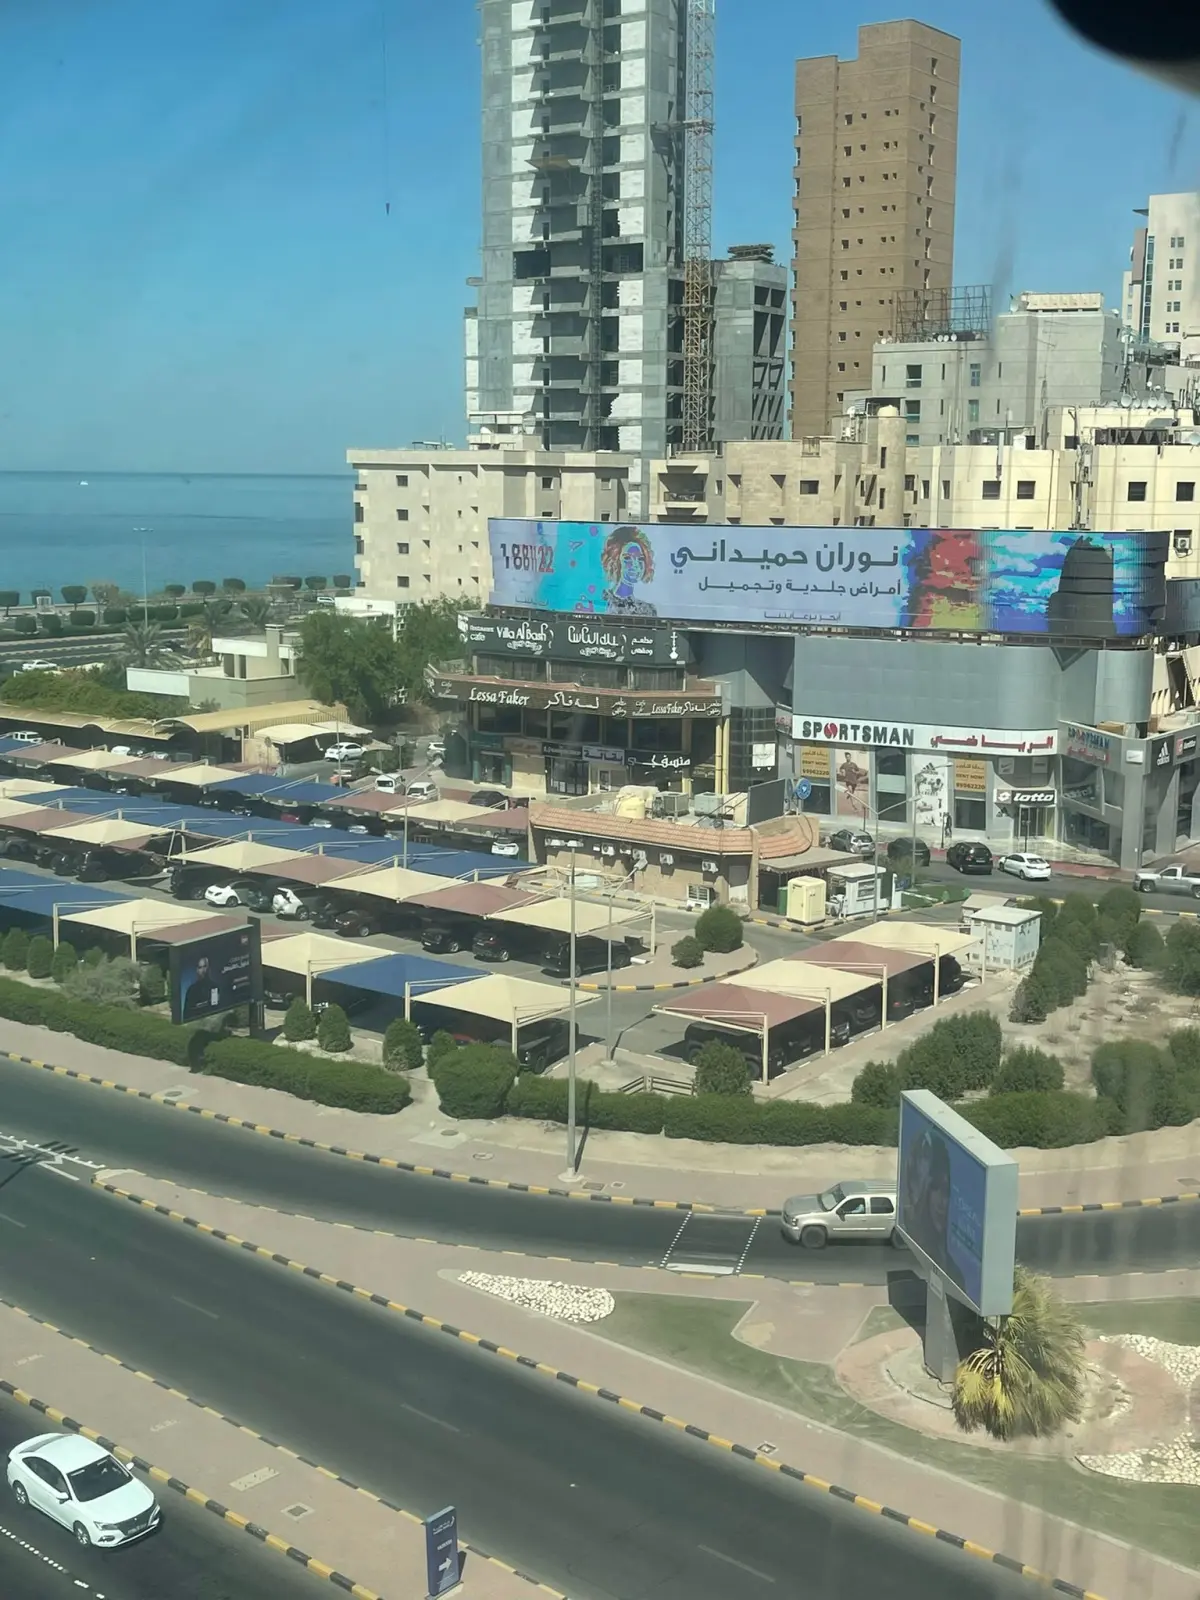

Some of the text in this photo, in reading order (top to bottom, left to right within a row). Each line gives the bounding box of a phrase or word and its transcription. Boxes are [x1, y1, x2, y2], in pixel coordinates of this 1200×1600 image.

[670, 539, 899, 574] نوران حميداني
[698, 576, 901, 597] أمراض جلدية وتجميل
[496, 626, 515, 639] Villa
[631, 636, 653, 646] مطعم
[469, 687, 497, 703] Lessa
[498, 688, 530, 706] Faker
[543, 691, 573, 709] فاكر
[802, 720, 914, 746] SPORTSMAN
[1013, 792, 1054, 802] lotto
